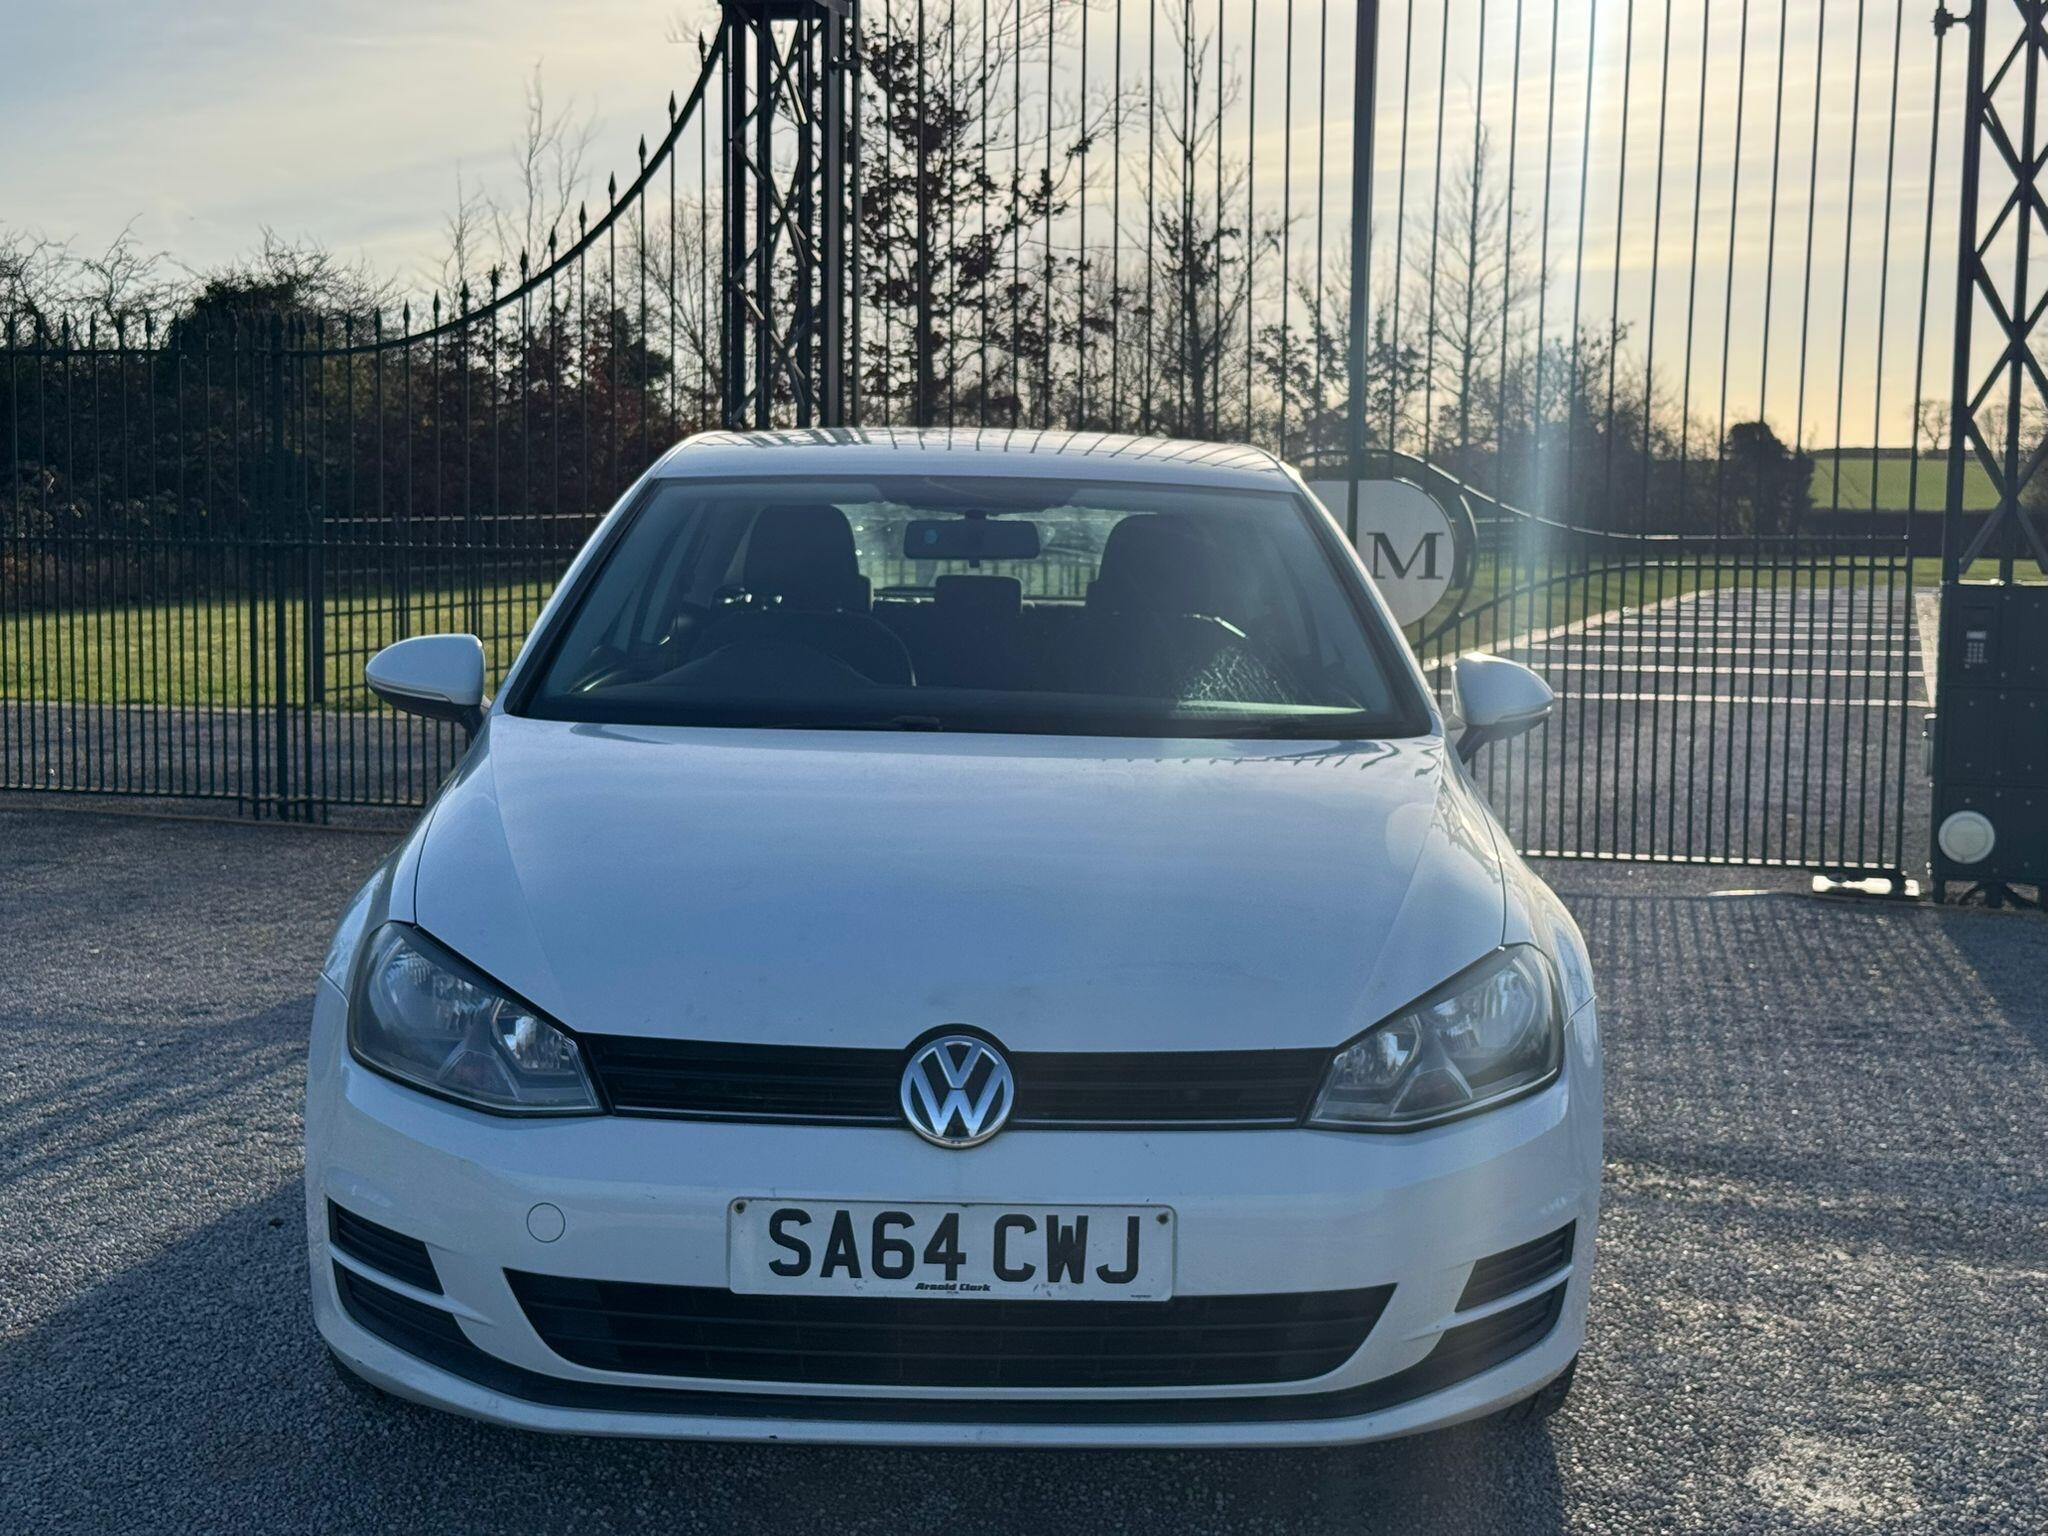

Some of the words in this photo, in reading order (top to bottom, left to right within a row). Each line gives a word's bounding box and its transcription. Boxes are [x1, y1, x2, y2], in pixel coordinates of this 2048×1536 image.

[1366, 531, 1445, 580] M
[768, 1207, 967, 1282] SA64
[992, 1213, 1141, 1285] CWJ
[915, 1282, 957, 1291] Arnold
[959, 1283, 991, 1292] Clark
